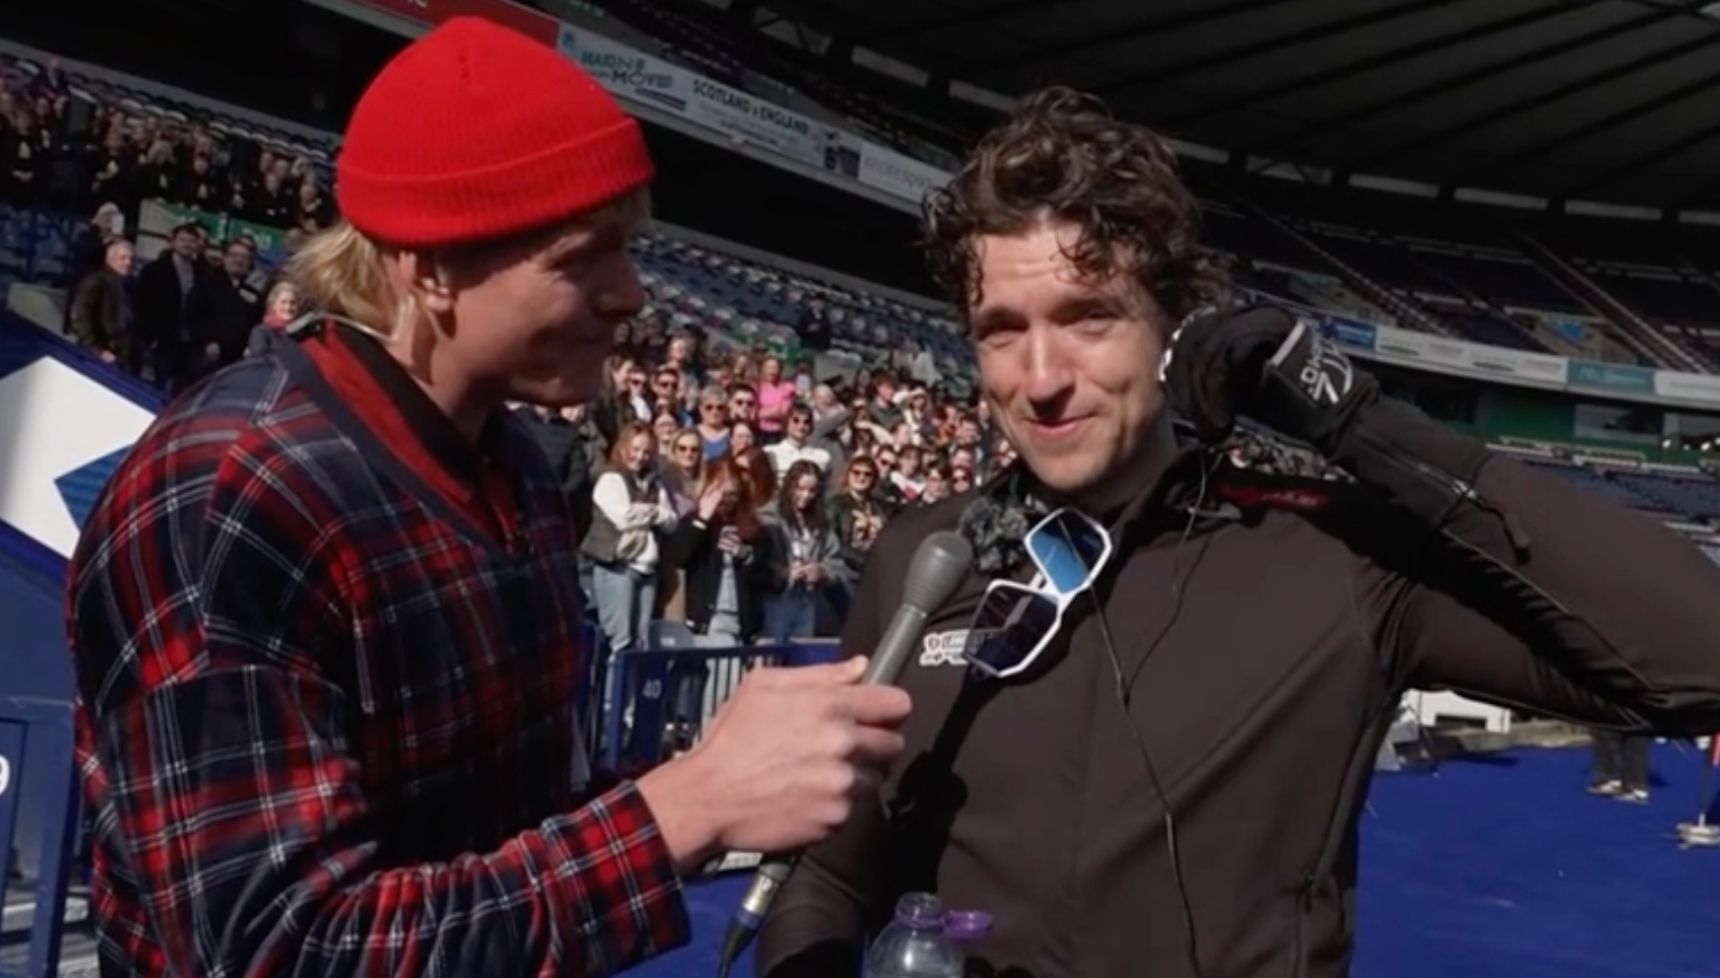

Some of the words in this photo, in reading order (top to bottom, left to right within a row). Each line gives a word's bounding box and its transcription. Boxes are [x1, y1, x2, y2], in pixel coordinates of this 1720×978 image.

[692, 79, 751, 115] SCOTLAND
[759, 106, 809, 135] ENGLAND
[643, 678, 662, 699] 40
